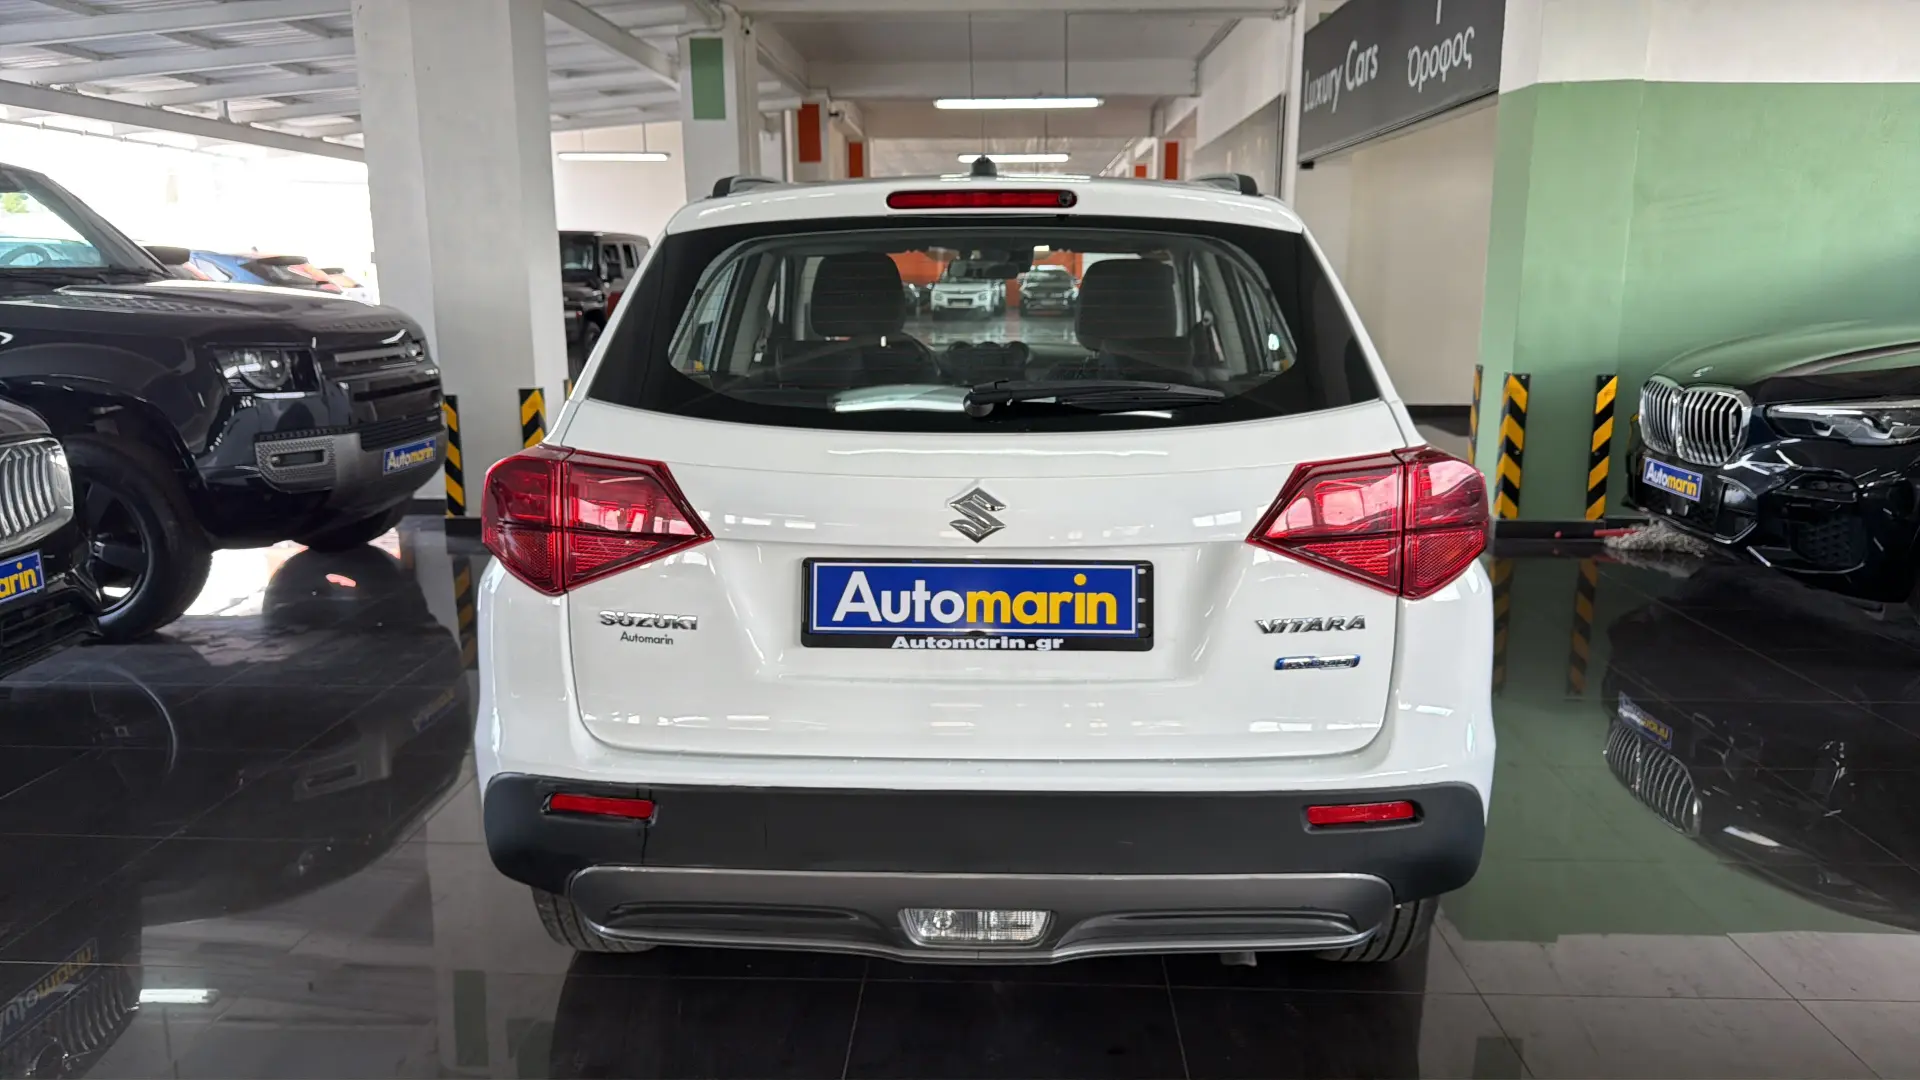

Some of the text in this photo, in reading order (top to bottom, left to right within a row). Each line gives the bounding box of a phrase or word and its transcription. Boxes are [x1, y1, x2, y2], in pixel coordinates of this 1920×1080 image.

[1304, 40, 1379, 114] Luxury Cars
[388, 441, 434, 471] Automarin
[1645, 462, 1697, 497] Automarin
[832, 570, 1118, 625] Automarin
[599, 610, 698, 630] SUZUKI
[1255, 615, 1366, 634] VITARA
[620, 631, 674, 645] Automarin
[891, 636, 1065, 651] Automarin.gr
